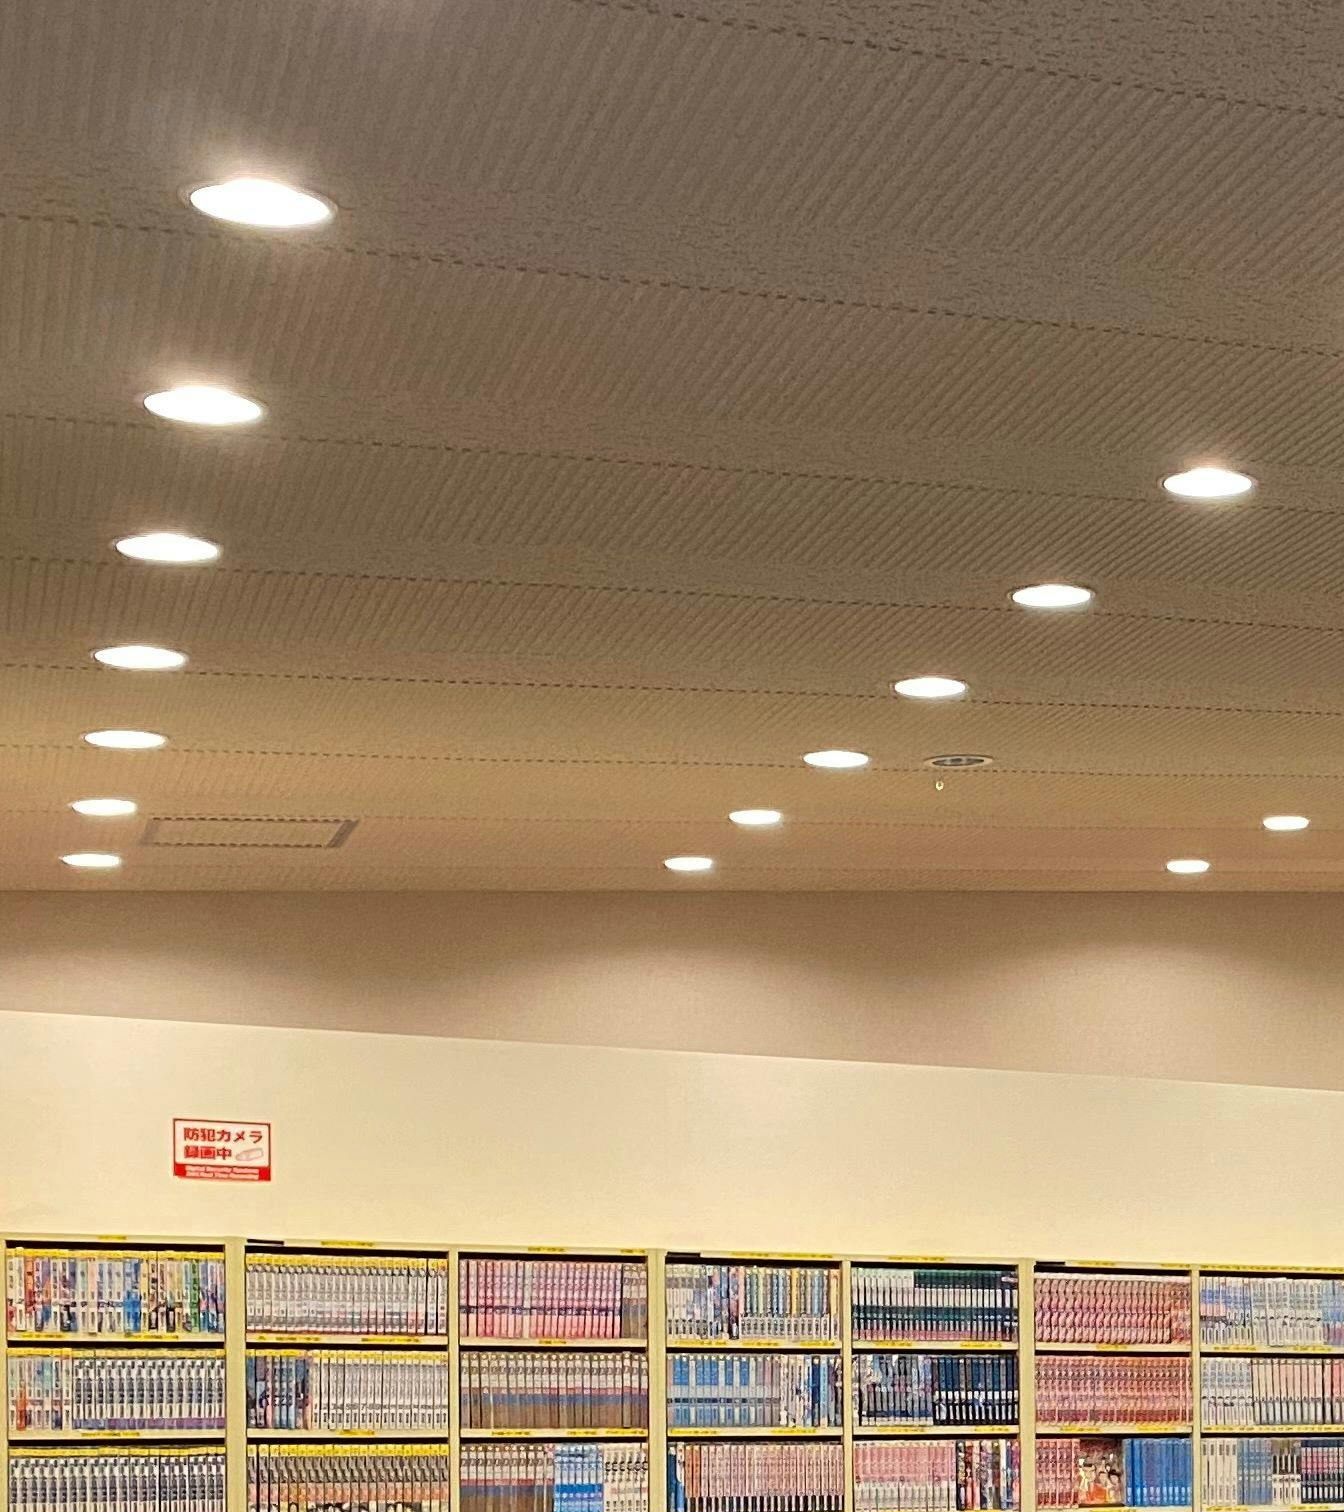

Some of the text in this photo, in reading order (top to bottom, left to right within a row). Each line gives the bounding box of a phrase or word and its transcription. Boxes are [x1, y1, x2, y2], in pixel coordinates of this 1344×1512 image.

[184, 1127, 263, 1143] 防犯カメラ
[184, 1145, 232, 1160] 録画中
